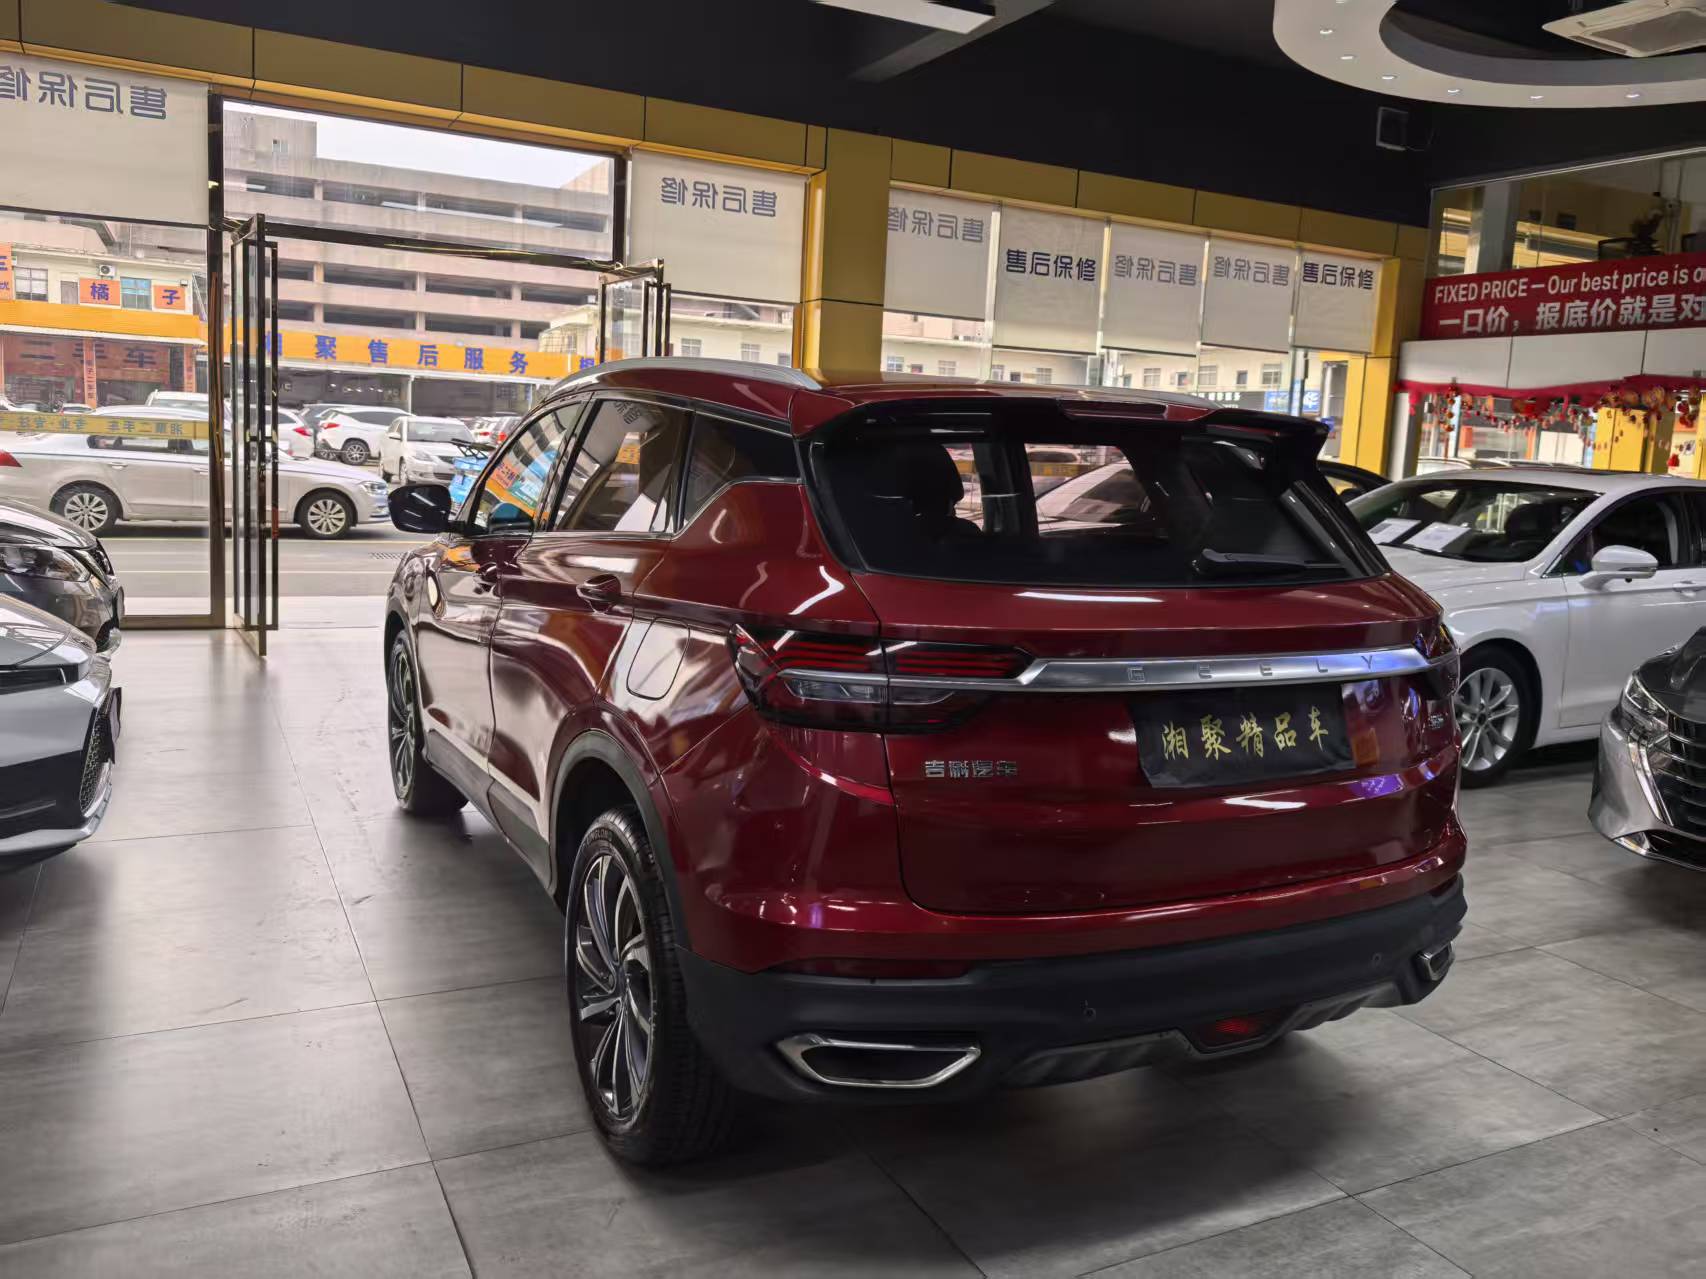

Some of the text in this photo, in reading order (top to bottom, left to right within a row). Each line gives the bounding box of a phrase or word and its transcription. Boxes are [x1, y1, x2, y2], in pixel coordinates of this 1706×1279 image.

[1005, 248, 1097, 282] 售后保修
[1302, 261, 1375, 290] 售后保修
[1434, 282, 1478, 304] FIXED
[1480, 278, 1528, 300] PRICE
[1547, 275, 1578, 294] Our
[1580, 270, 1619, 291] best
[1621, 266, 1669, 294] price
[1673, 264, 1689, 284] is
[1693, 266, 1706, 283] o
[1127, 654, 1374, 683] GEELY
